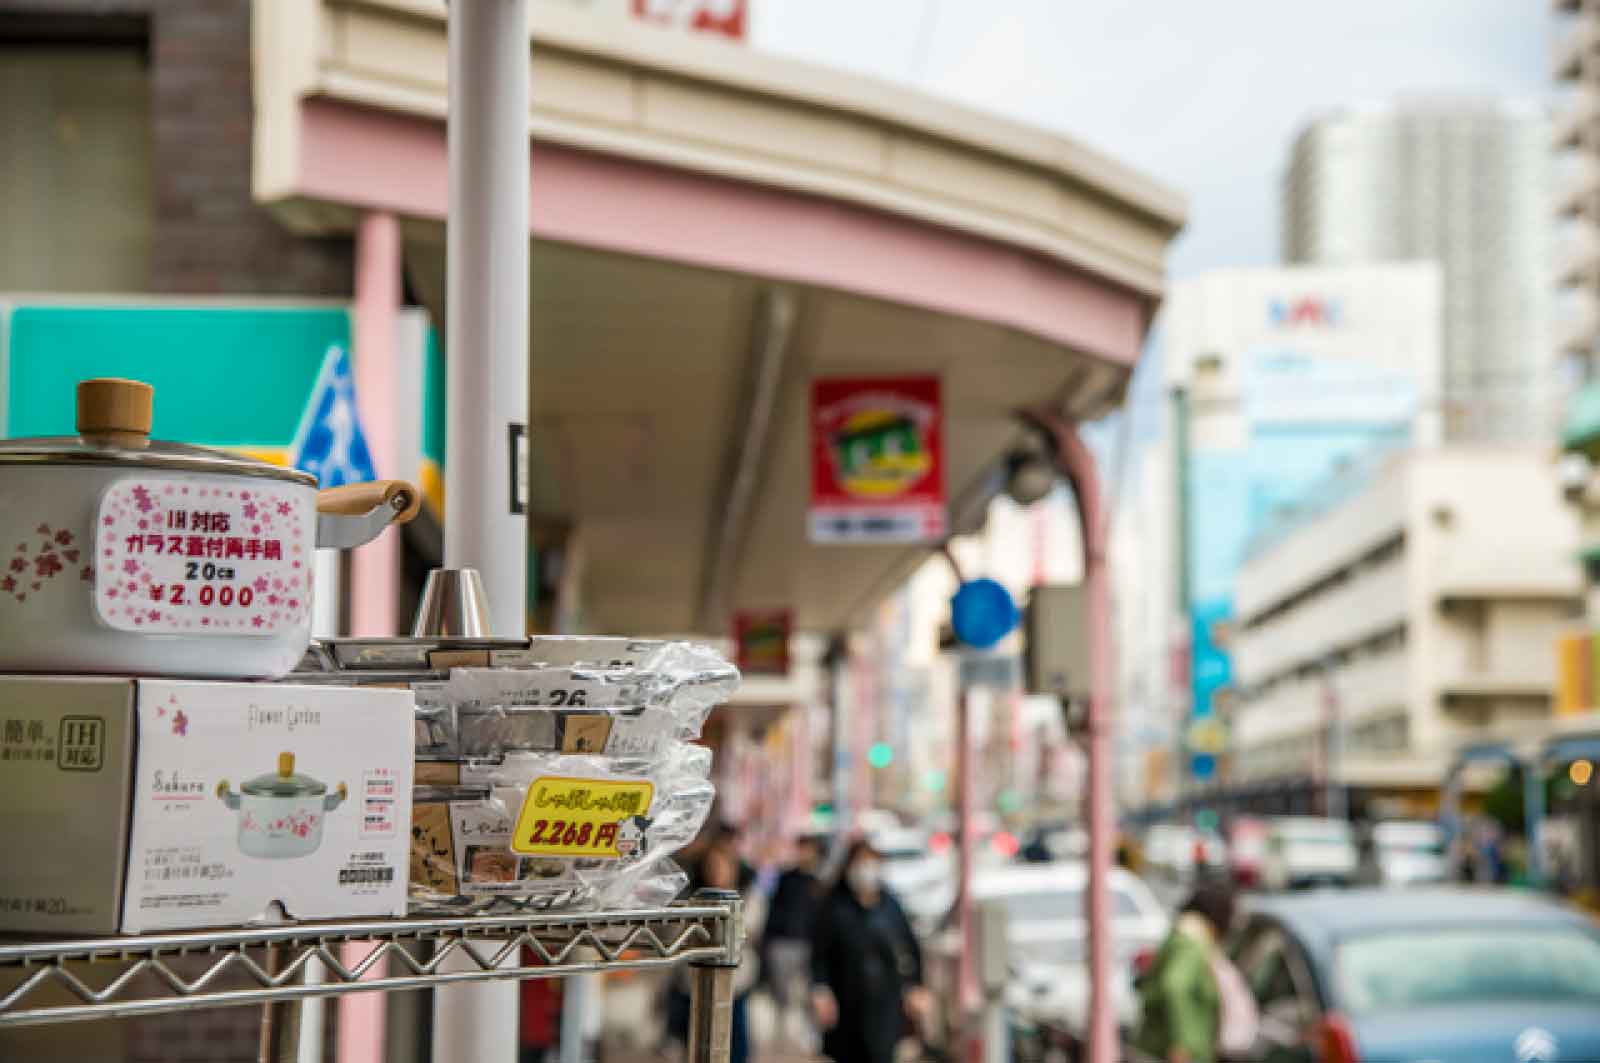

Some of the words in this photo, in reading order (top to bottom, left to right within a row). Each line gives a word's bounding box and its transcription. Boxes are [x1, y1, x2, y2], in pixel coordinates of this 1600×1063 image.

[125, 535, 281, 561] ガラス蓋付両手鍋
[66, 721, 97, 746] IH
[152, 768, 205, 793] Sakura
